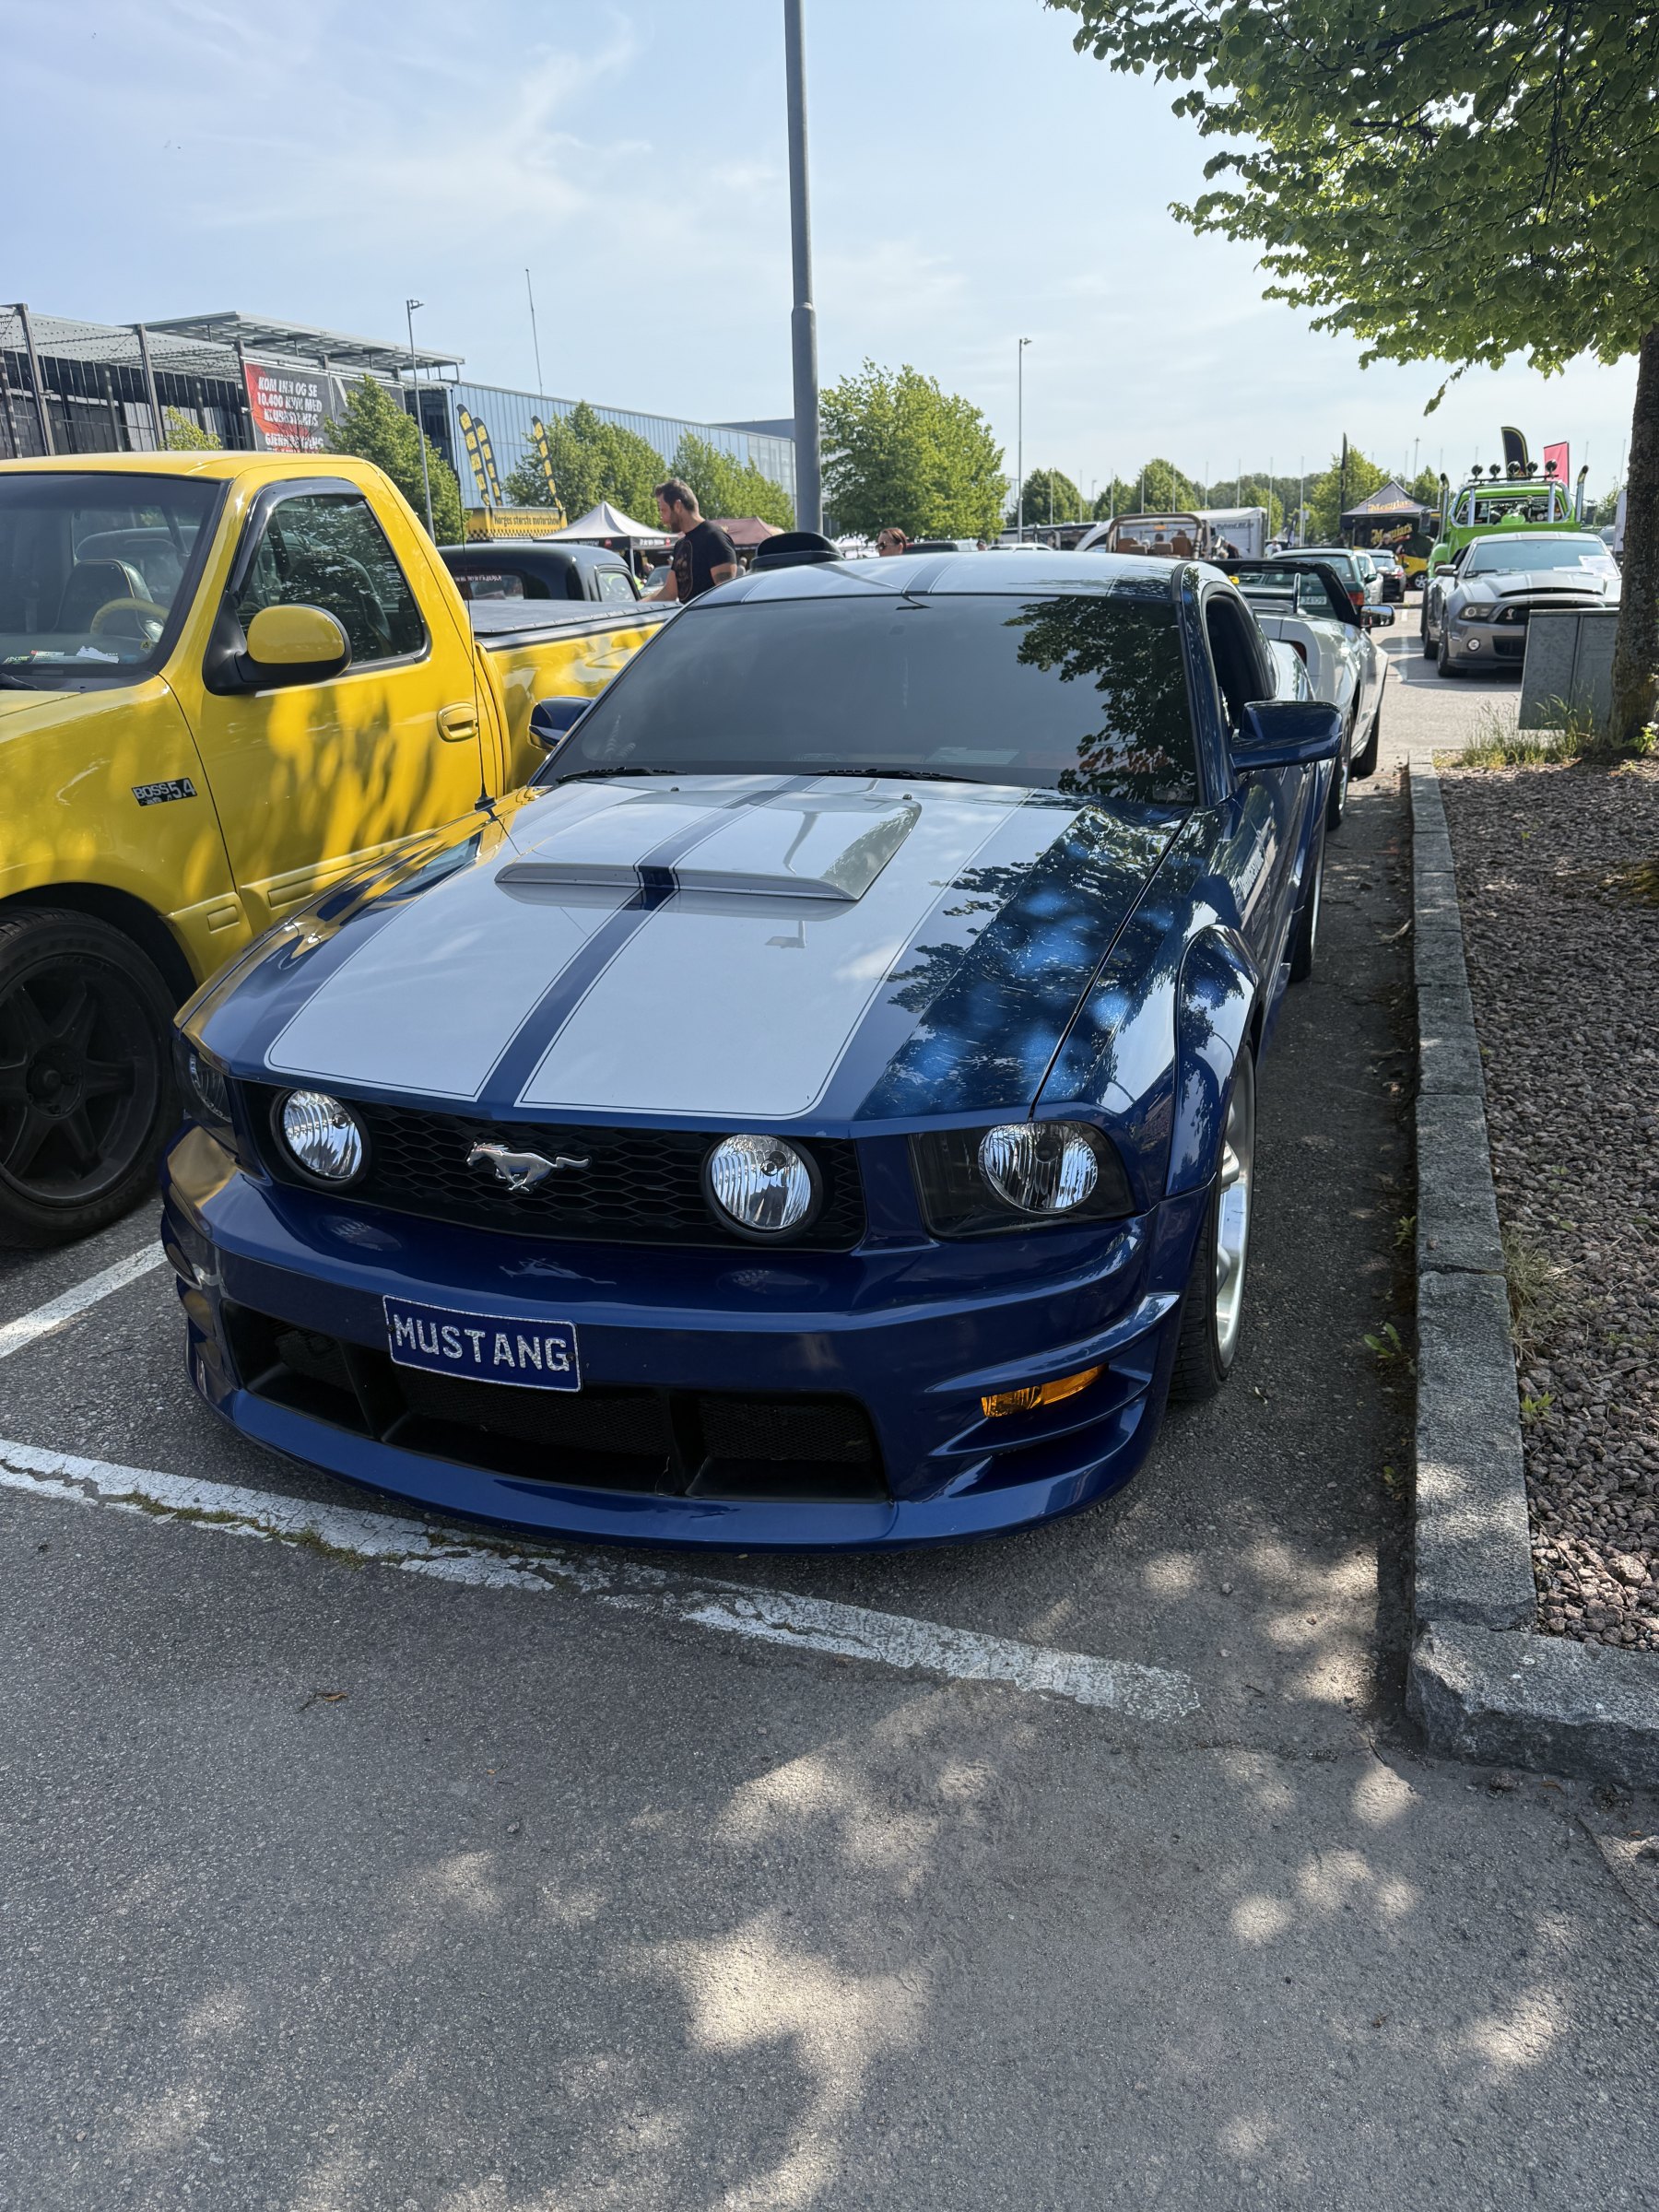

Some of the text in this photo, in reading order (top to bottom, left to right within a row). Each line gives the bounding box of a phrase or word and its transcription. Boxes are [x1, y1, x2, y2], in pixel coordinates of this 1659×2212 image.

[258, 377, 318, 397] KOM INN OG SE
[257, 392, 283, 407] 10.400
[304, 398, 323, 413] MED
[494, 515, 512, 527] Norges
[133, 779, 196, 800] BOSS 5.4
[393, 1313, 571, 1372] MUSTANG
